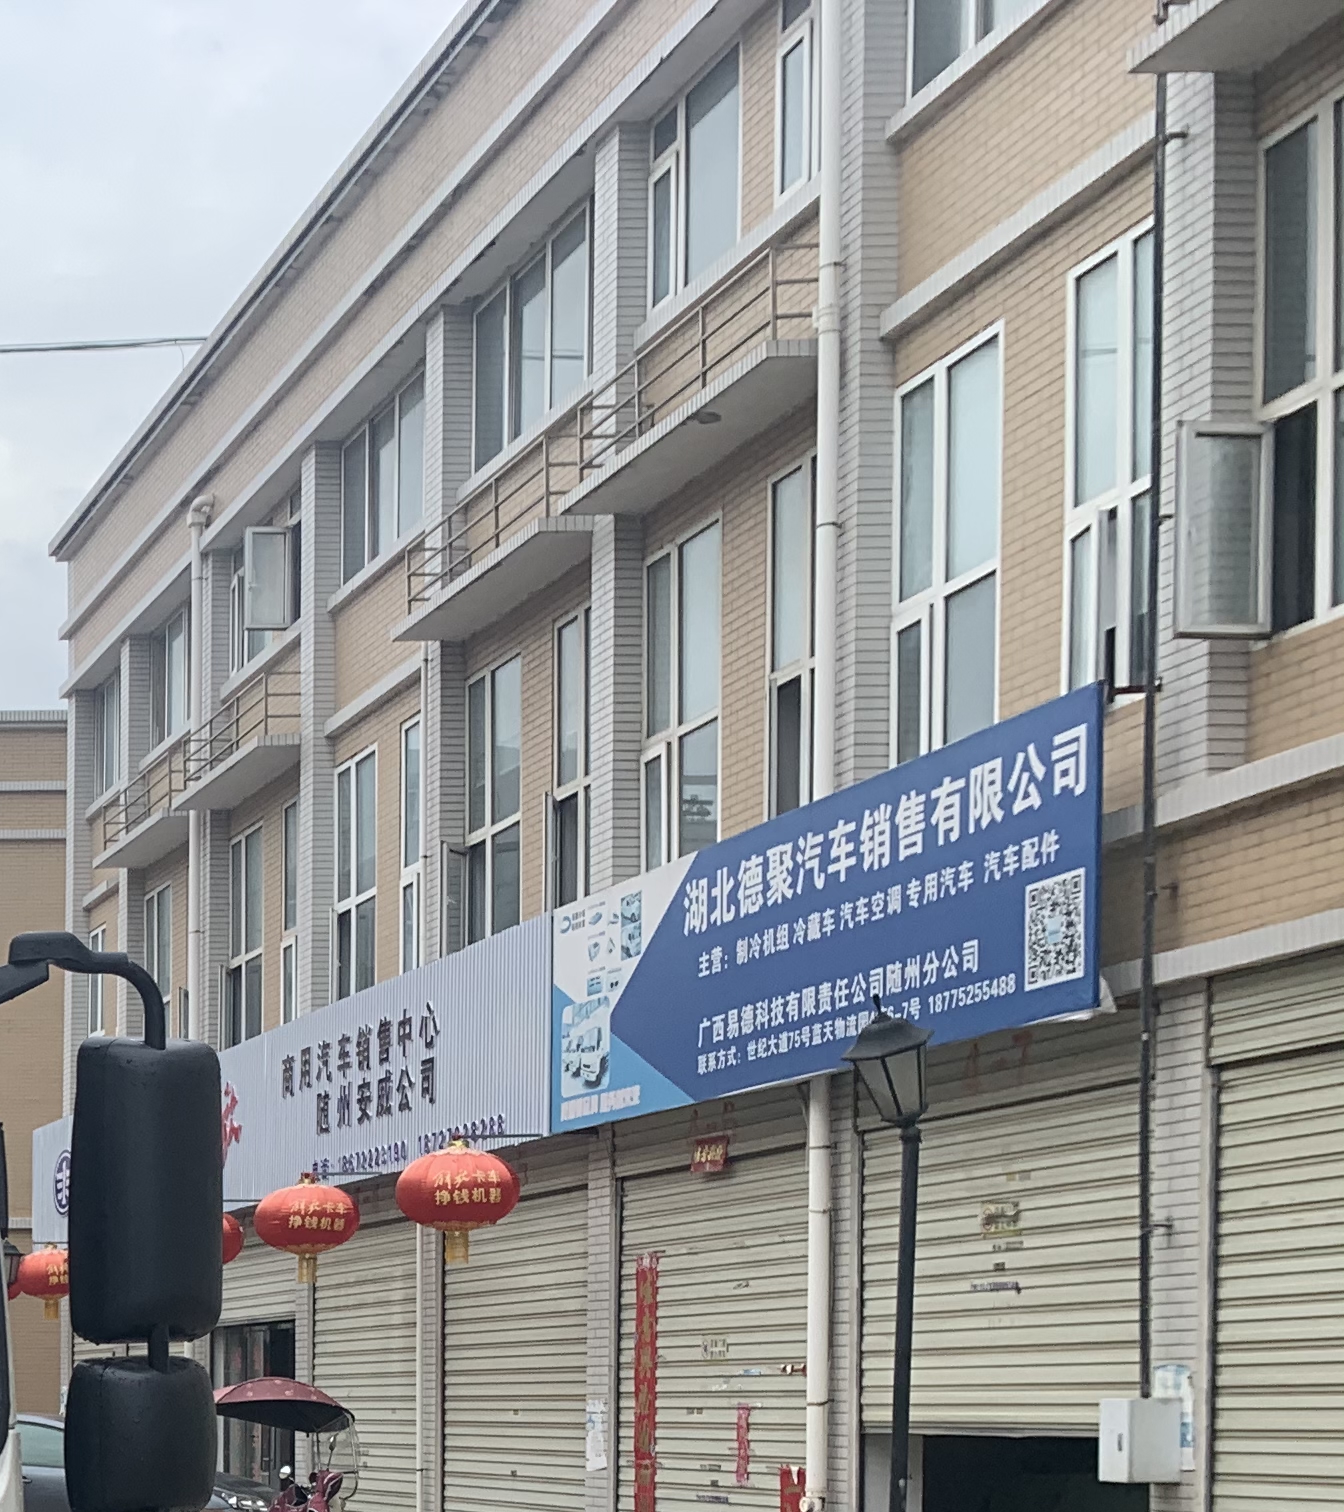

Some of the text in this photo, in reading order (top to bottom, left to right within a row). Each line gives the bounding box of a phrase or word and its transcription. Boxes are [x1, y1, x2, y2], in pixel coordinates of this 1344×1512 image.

[683, 723, 1089, 937] 湖北德聚汽车销售有限公司
[736, 923, 790, 965] 制冷机组
[793, 908, 836, 944] 冷藏车
[840, 884, 902, 931] 汽车空调
[906, 860, 974, 908] 专用汽车
[983, 829, 1060, 883] 汽车配件
[281, 1001, 441, 1100] 商用汽车销售中心
[697, 1046, 741, 1076] 联系方式：
[928, 973, 1017, 1015] 18775255488
